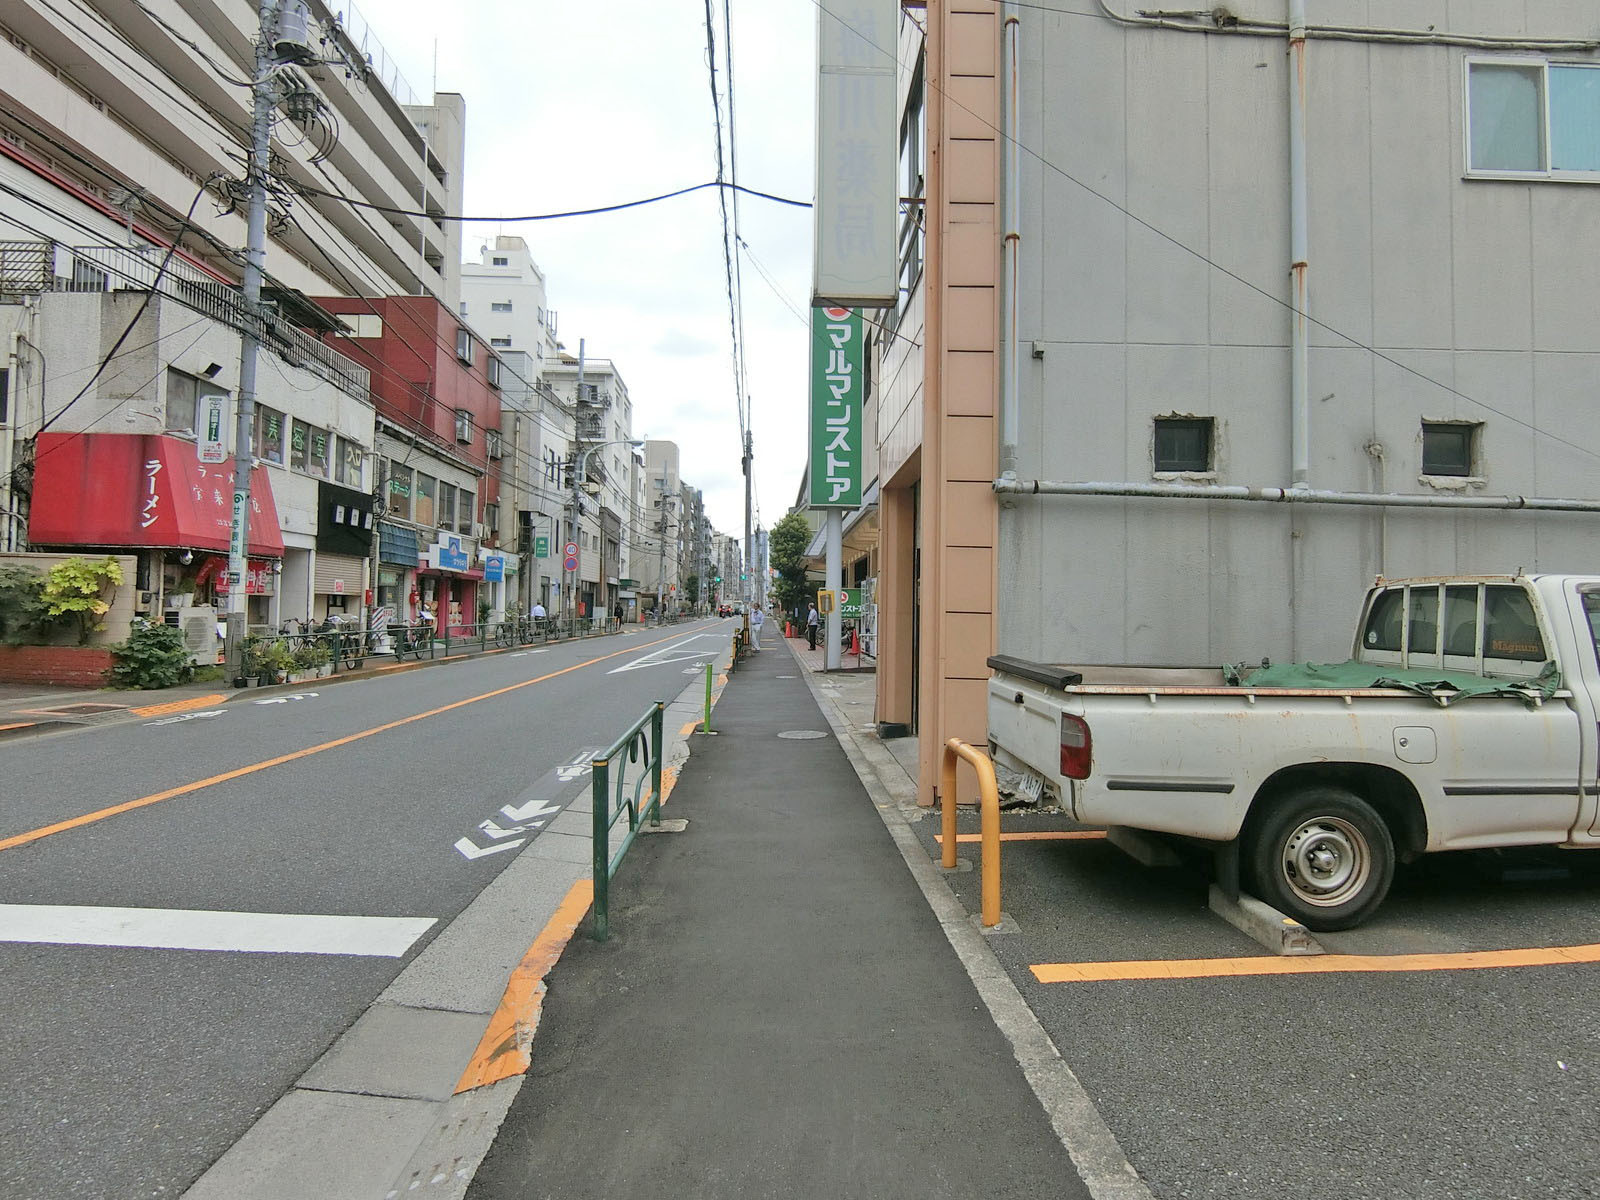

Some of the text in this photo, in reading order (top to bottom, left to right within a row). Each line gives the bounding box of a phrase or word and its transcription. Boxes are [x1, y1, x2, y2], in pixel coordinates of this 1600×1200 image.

[825, 324, 852, 502] マルマンストア
[141, 459, 163, 528] ラーメン
[197, 465, 235, 484] ラーメ
[1492, 639, 1539, 655] Magnum
